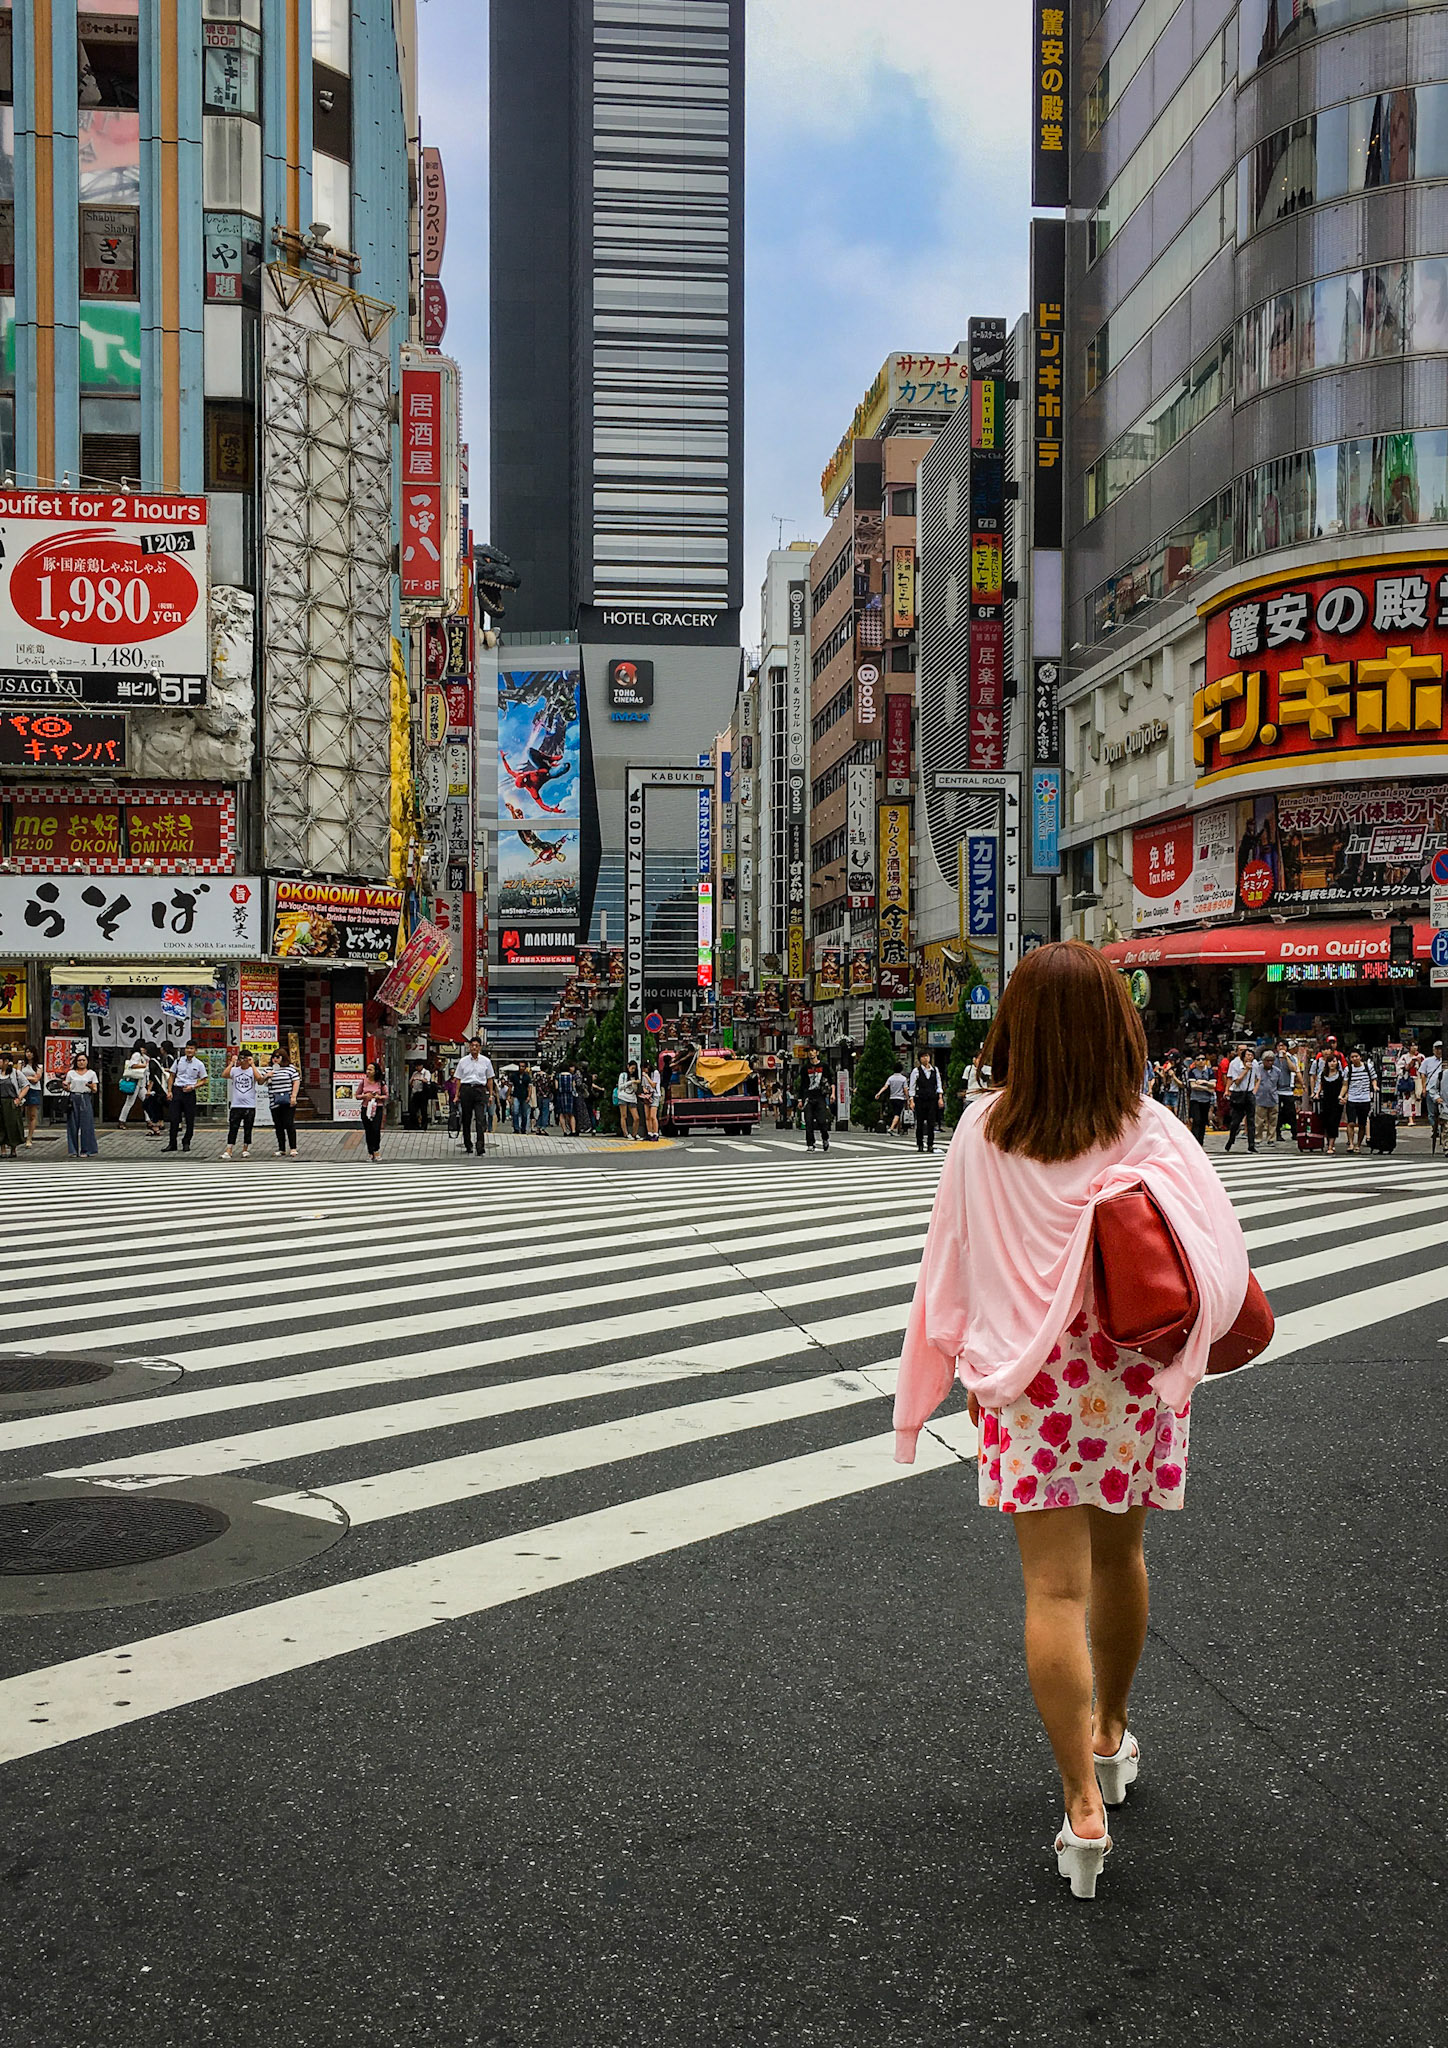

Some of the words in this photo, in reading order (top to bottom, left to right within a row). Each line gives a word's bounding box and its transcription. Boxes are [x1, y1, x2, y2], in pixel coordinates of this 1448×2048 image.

[207, 35, 235, 46] 100円
[1040, 8, 1064, 152] 驚安の殿堂
[86, 213, 116, 222] Shabu
[104, 223, 135, 234] Shabu
[212, 243, 238, 269] や
[215, 274, 236, 297] 題
[896, 354, 959, 379] サウナ
[959, 364, 968, 378] &
[409, 393, 433, 475] 居酒屋
[70, 496, 104, 517] for
[111, 498, 127, 518] 2
[134, 499, 201, 521] hours
[403, 493, 440, 562] つぼ八
[980, 520, 996, 528] 7F
[145, 533, 191, 554] 120分
[43, 557, 167, 574] 豚・国産鶏しゃぶしゃぶ
[35, 575, 151, 629] 1,980
[791, 590, 803, 628] Booth
[153, 610, 182, 625] yen
[603, 612, 650, 625] HOTEL
[652, 612, 718, 627] GRACERY
[978, 606, 995, 618] 6F
[898, 629, 910, 637] 6F
[16, 643, 45, 654] 国産鶏
[91, 647, 143, 668] 1,480
[143, 658, 165, 669] yen
[16, 654, 87, 667] しゃぶしゃぶコース
[977, 647, 996, 705] 居楽屋
[117, 681, 157, 697] 当ビル
[160, 678, 201, 703] 5F
[857, 664, 880, 724] Booth
[610, 712, 650, 722] IMAX
[1104, 743, 1122, 766] Don
[1125, 722, 1163, 753] Quijote
[453, 785, 463, 793] 3F
[938, 777, 980, 785] CENTRAL
[982, 777, 1007, 785] ROAD
[790, 776, 803, 814] Booth
[1278, 795, 1319, 808] Attraction
[1321, 793, 1343, 804] built
[1343, 791, 1359, 802] for
[1360, 791, 1367, 799] a
[1367, 788, 1391, 799] real
[1391, 787, 1411, 800] spy
[429, 806, 439, 814] 1F
[850, 767, 867, 846] バリバリ鶏
[1278, 796, 1448, 832] 本格スパイ体験アト
[14, 816, 58, 836] me
[15, 838, 53, 850] 12:00
[887, 810, 901, 885] きんくら酒場
[629, 805, 641, 923] GODZILLA
[1149, 841, 1175, 870] 免税
[502, 878, 577, 889] スパイダーマン
[972, 840, 994, 932] カラオケ
[1149, 871, 1161, 885] Tax
[1161, 869, 1175, 883] Free
[236, 887, 245, 901] 旨
[278, 882, 360, 905] OKONOMI
[364, 889, 403, 907] YAKI
[531, 896, 546, 906] 8.11
[852, 896, 870, 908] B1
[1273, 883, 1438, 902] 「ドンキ看板を見た」でアトラクション
[0, 881, 211, 941] らそば
[277, 901, 328, 913] All-You-Can-Eat
[328, 905, 348, 914] dinner
[348, 906, 362, 914] with
[362, 907, 401, 918] Free-Flowing
[326, 912, 347, 922] Drinks
[347, 914, 356, 922] for
[361, 916, 380, 924] hours
[791, 907, 802, 915] 4F
[791, 915, 802, 923] 3F
[524, 932, 575, 947] MARUHAN
[880, 903, 909, 965] 金の蔵
[1124, 951, 1138, 964] Don
[1138, 949, 1162, 965] Quijote
[1280, 942, 1319, 957] Don
[1325, 939, 1391, 959] Quijot
[629, 935, 641, 992] ROAD
[881, 970, 900, 986] 2F
[163, 986, 187, 1006] 氷
[644, 989, 658, 998] HO
[660, 989, 704, 998] CINEMAS
[242, 997, 277, 1011] 2,700円
[98, 1015, 190, 1039] とらそば
